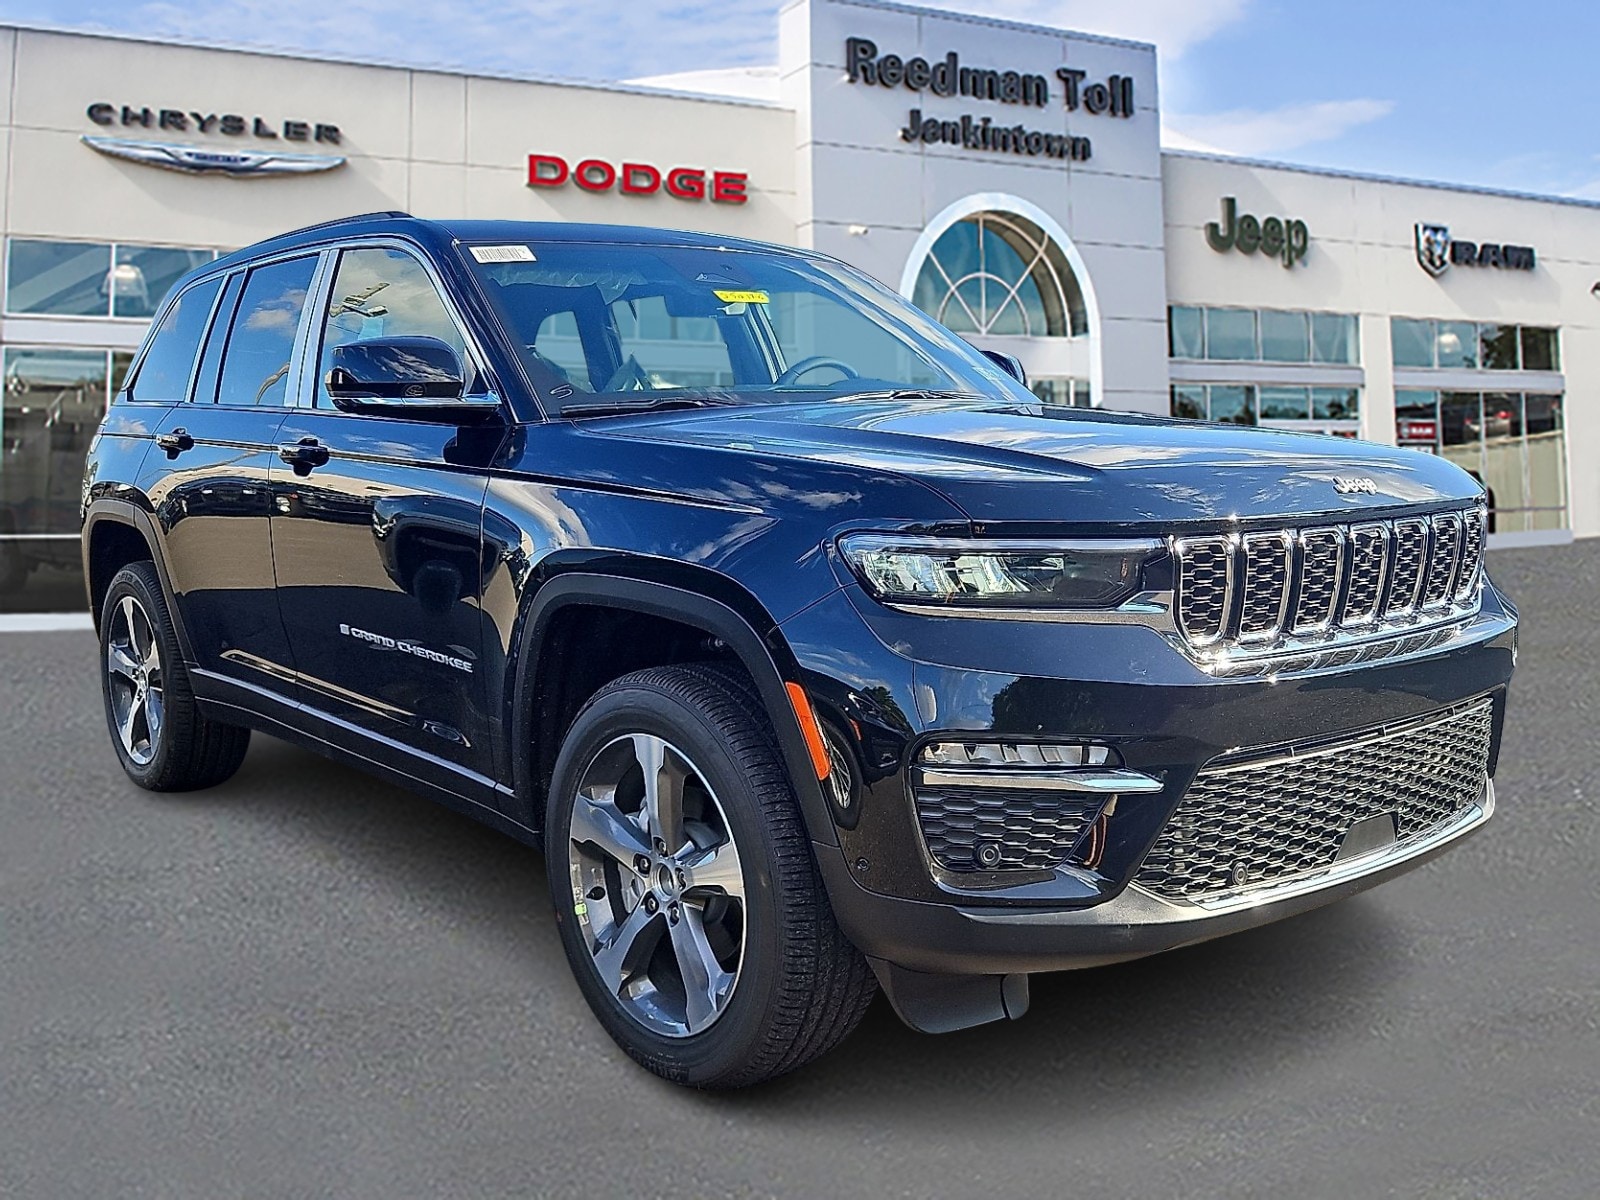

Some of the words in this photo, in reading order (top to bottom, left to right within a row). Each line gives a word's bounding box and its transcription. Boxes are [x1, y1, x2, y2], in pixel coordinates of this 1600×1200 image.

[845, 37, 1048, 107] Reedman
[1056, 67, 1133, 118] Toll
[87, 102, 341, 145] CHRYSLER
[901, 108, 1091, 161] Jenkintown
[527, 154, 748, 203] DODGE
[1204, 196, 1308, 269] Jeep
[1450, 240, 1535, 270] RAM
[1332, 476, 1377, 495] Jeep
[350, 627, 395, 648] GRAND
[397, 641, 473, 673] CHEROKEE
